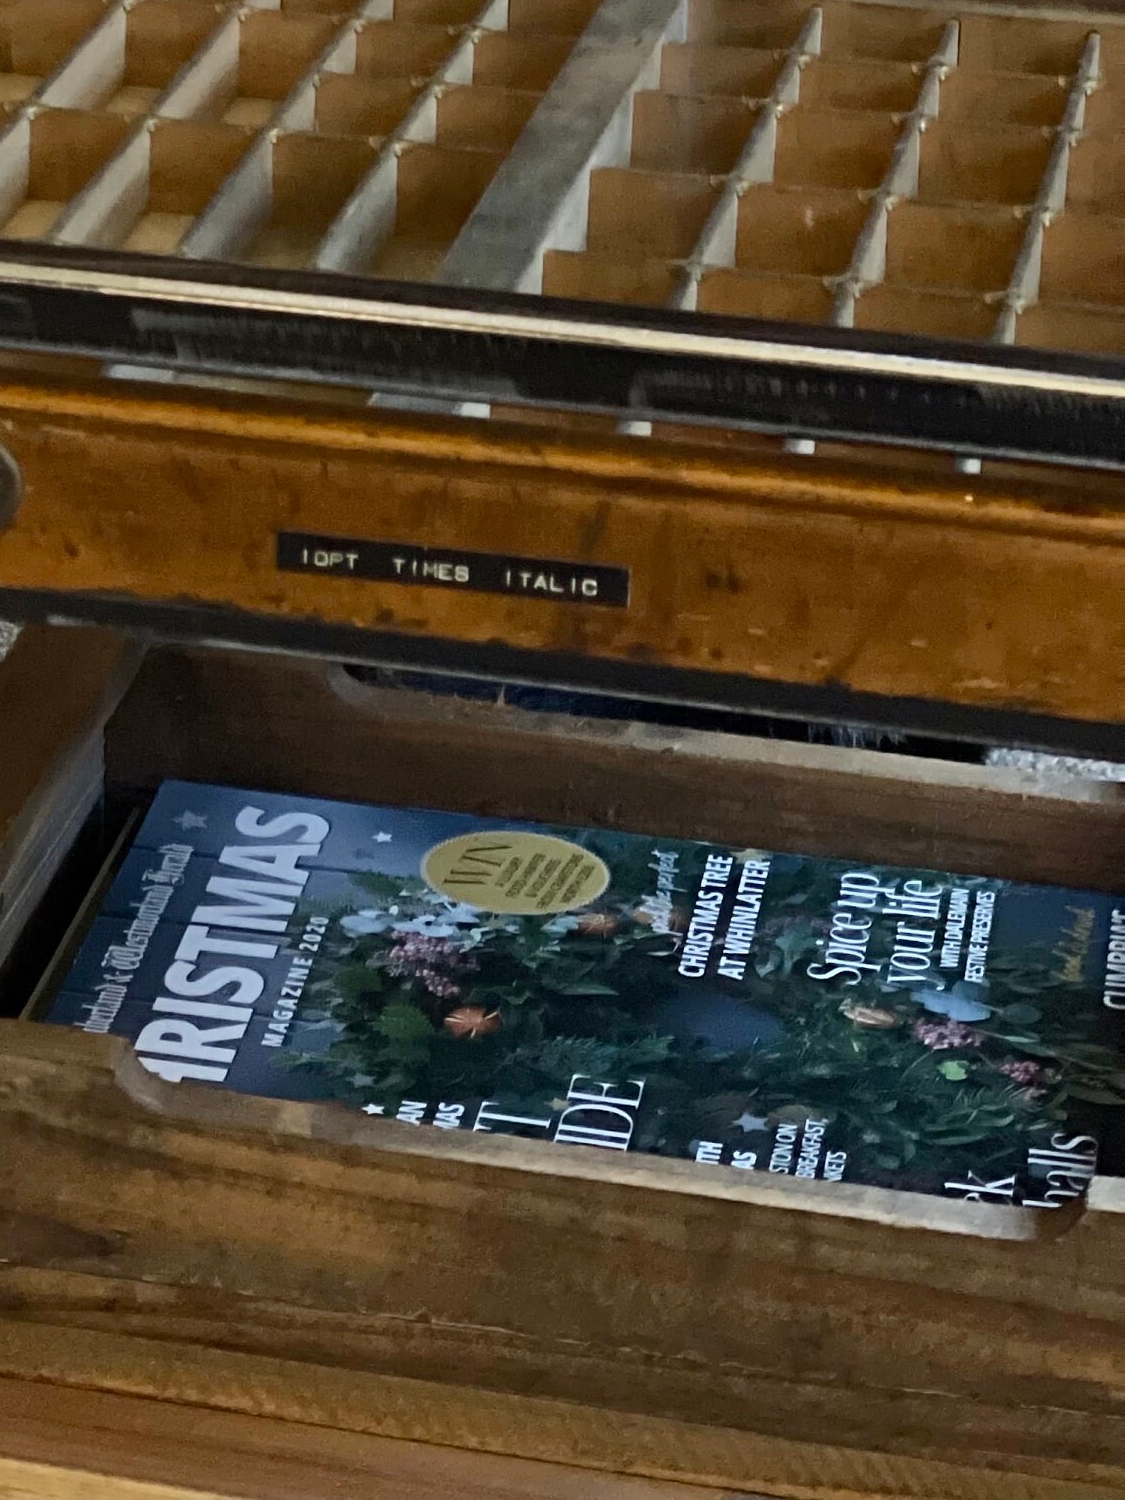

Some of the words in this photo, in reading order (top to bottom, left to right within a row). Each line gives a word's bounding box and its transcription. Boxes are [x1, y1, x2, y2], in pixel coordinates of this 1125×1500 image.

[392, 557, 470, 582] TIMES
[506, 569, 599, 597] ITALIC
[700, 854, 733, 888] TREE
[837, 872, 896, 908] up
[723, 860, 771, 954] WHINLATTER
[881, 880, 943, 920] life
[944, 888, 970, 941] DALEMAIN
[970, 890, 996, 943] PRESERVES
[678, 890, 724, 978] CHRISTMAS
[806, 912, 881, 985] Spice
[886, 921, 945, 991] your
[939, 940, 963, 968] WITH
[261, 956, 314, 1047] MAGAZINE
[299, 916, 330, 953] 2020
[717, 956, 747, 980] AT
[964, 939, 989, 984] FESTIVE
[776, 1124, 798, 1144] ON
[795, 1117, 830, 1179] BREAKFAST,
